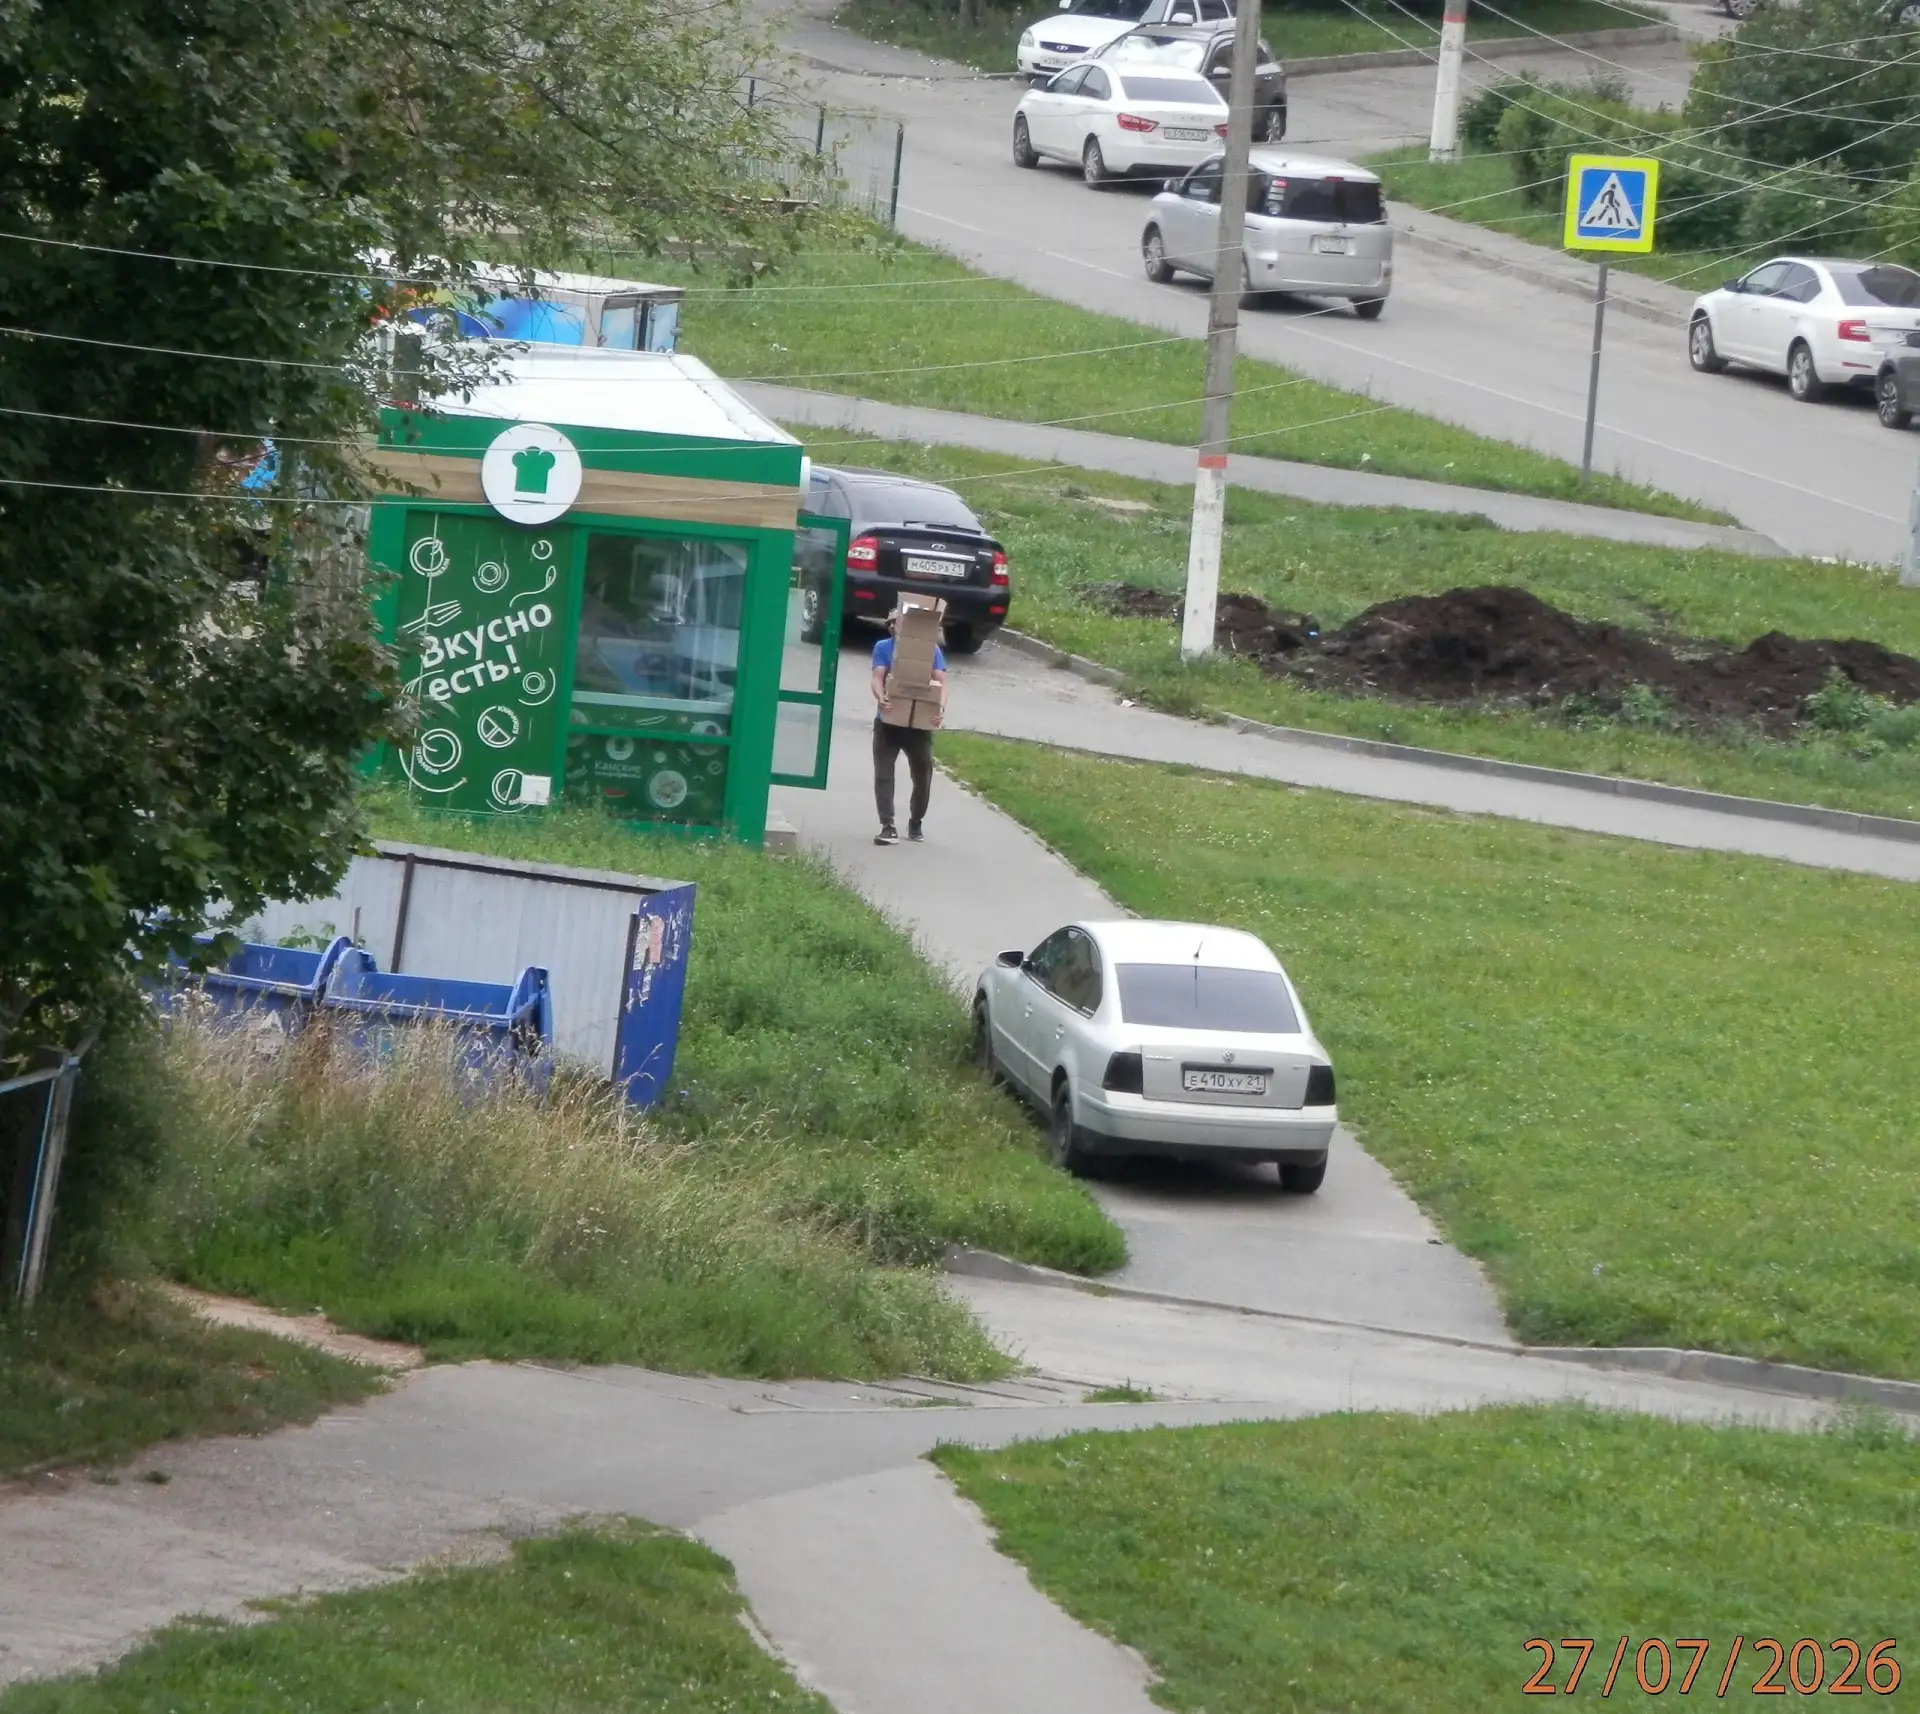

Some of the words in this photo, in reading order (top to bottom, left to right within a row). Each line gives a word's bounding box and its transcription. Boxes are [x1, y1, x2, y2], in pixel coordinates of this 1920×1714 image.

[421, 603, 552, 669] Вкусно
[428, 644, 521, 701] есть!
[1247, 1075, 1260, 1086] 21
